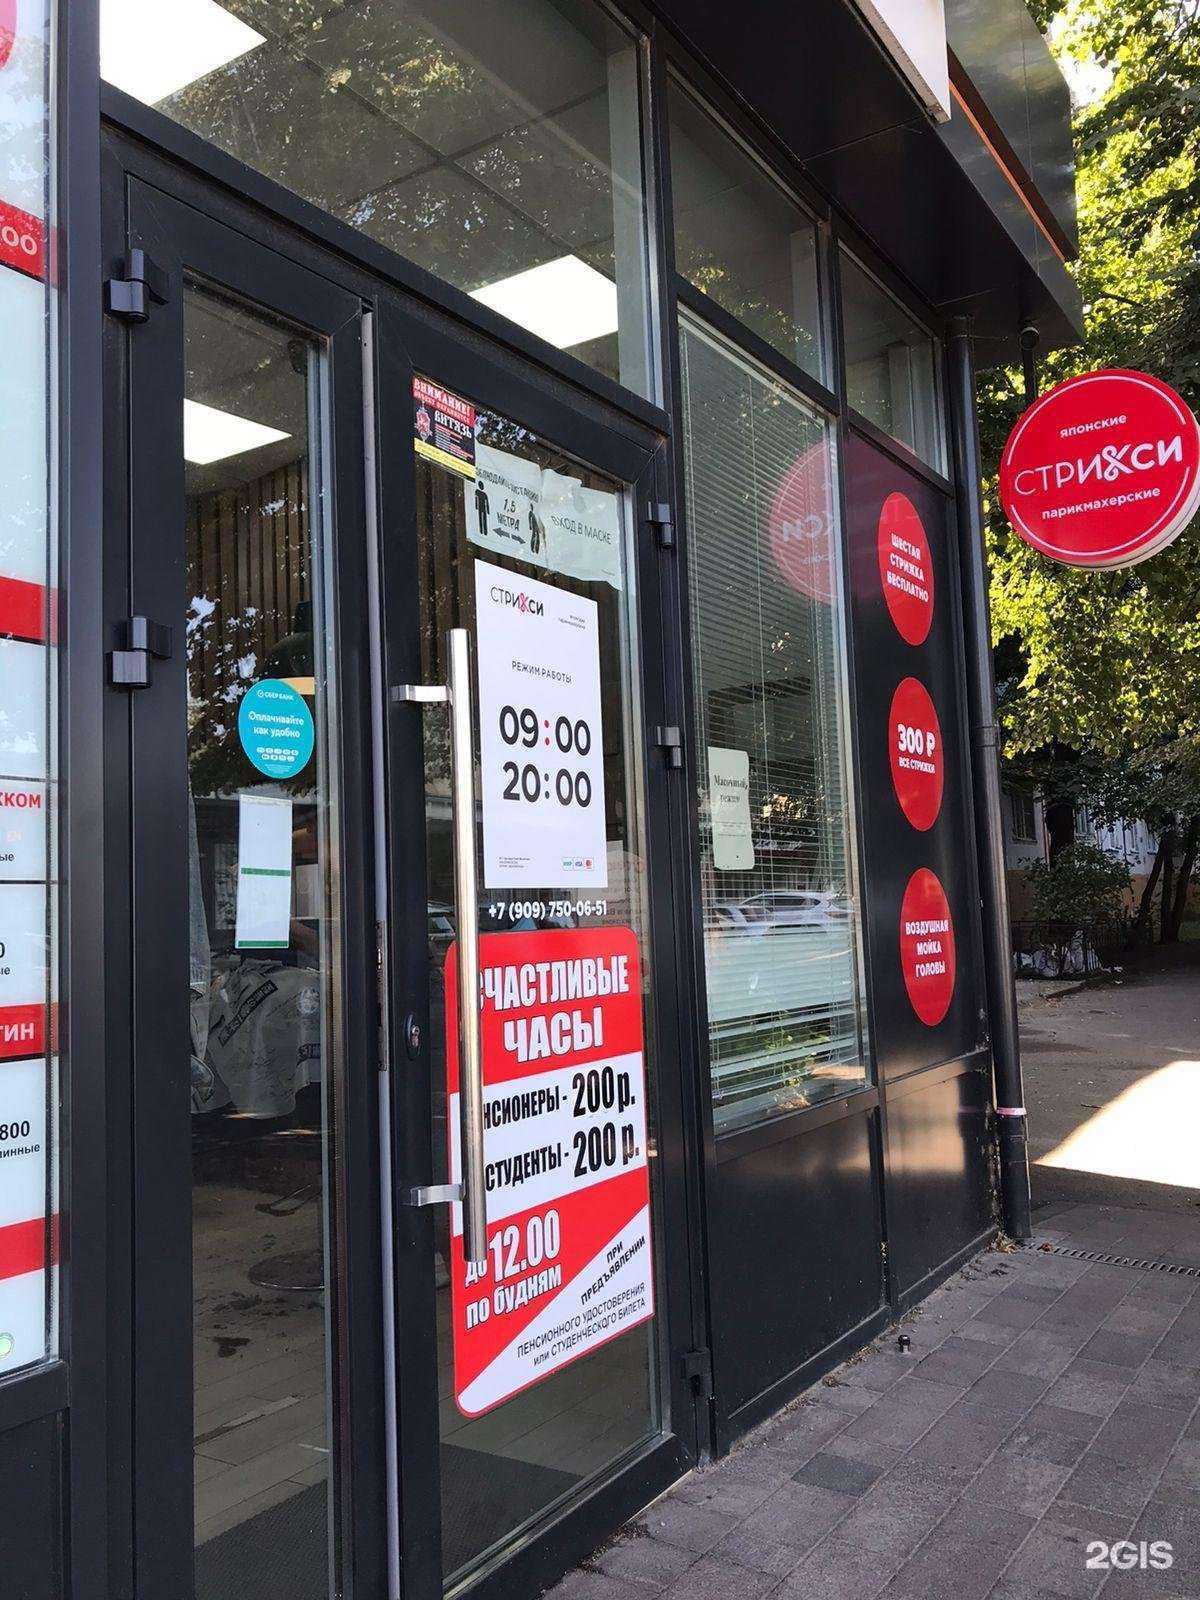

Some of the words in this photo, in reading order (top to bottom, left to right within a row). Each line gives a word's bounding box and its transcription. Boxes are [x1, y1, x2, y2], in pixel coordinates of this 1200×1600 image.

[434, 410, 472, 438] ВИТЯЗЬ
[1060, 414, 1127, 438] японские
[1041, 487, 1161, 520] парикмахерские
[497, 511, 520, 531] МЕТРА
[584, 525, 612, 545] МАСКЕ
[889, 552, 925, 583] СТРИЖКА
[886, 570, 930, 603] БЕСПЛАТНО
[512, 660, 541, 676] РЕЖИМ
[542, 668, 572, 684] РАБОТЫ
[248, 710, 305, 726] Оплачивайте
[254, 726, 268, 735] как
[270, 728, 301, 739] удобно
[499, 705, 591, 756] 09:00
[897, 723, 924, 756] 300
[503, 761, 591, 808] 20:00
[489, 902, 506, 920] +7
[508, 902, 547, 922] (909)
[549, 900, 607, 919] 750-06-51
[905, 919, 949, 936] ВОЗДУШНАЯ
[916, 938, 942, 956] МОЙКА
[915, 960, 946, 978] ГОЛОВЫ
[503, 1006, 604, 1063] ЧАСЫ
[572, 1066, 614, 1118] 200
[485, 1142, 561, 1192] СТУДЕНТЫ
[573, 1121, 616, 1178] 200
[488, 1209, 561, 1284] 12.00
[606, 1241, 623, 1264] ПРИ
[581, 1236, 646, 1305] ПРЕДЪЯВЛЕНИИ
[465, 1295, 490, 1331] по
[493, 1263, 562, 1316] будням
[517, 1314, 581, 1358] ПЕНСИОННОГО
[582, 1281, 645, 1326] УДОСТОВЕРЕНИЯ
[550, 1317, 617, 1357] СТУДЕНЧЕСКОГО
[618, 1298, 646, 1323] БИЛЕТА
